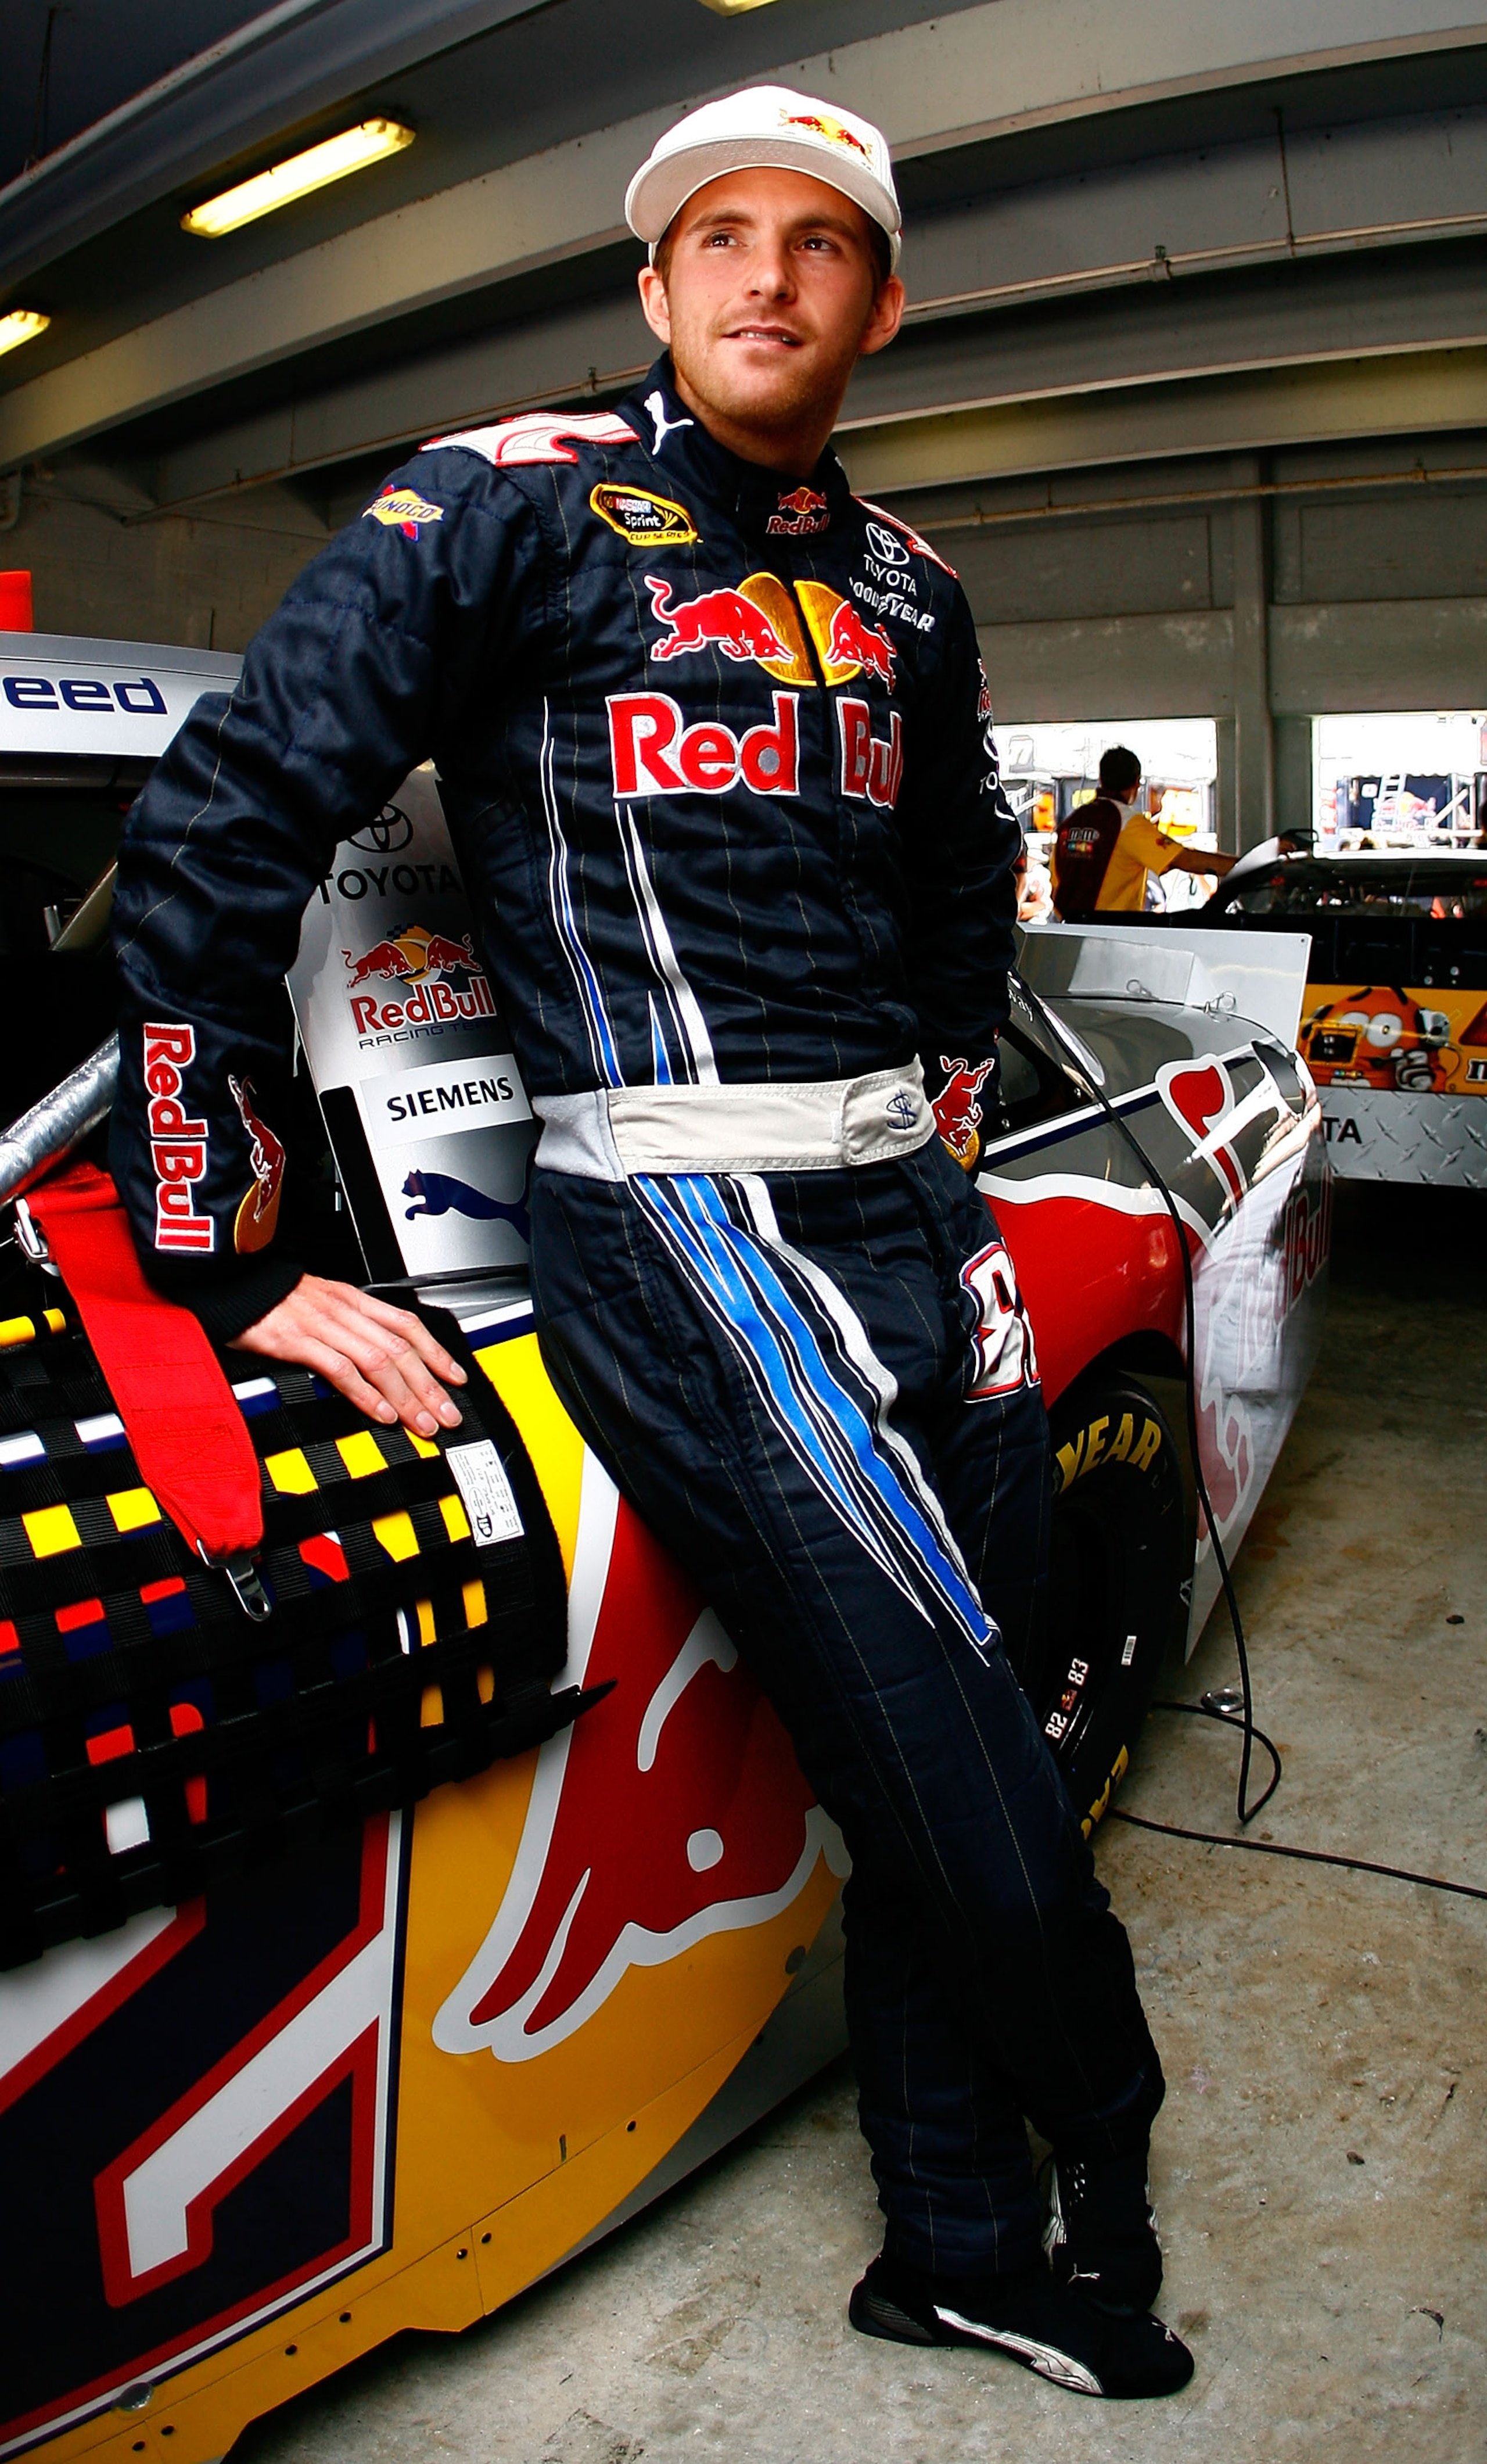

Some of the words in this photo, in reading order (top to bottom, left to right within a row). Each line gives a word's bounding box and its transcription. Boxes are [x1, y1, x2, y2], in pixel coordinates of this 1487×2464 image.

[624, 513, 662, 529] Sprint
[766, 515, 803, 535] Red
[863, 554, 918, 597] TOYOTA
[849, 576, 936, 633] OODYEAR
[605, 691, 800, 798] Red
[835, 695, 903, 810] Bull
[318, 865, 463, 905] TOYOTA
[347, 983, 434, 1036] Red
[430, 975, 498, 1024] Bull
[359, 1023, 444, 1050] RACING
[143, 1022, 209, 1140] Red
[386, 1076, 514, 1122] SIEMENS
[150, 1140, 215, 1253] Bull
[1055, 1412, 1162, 1494] YEAR
[1068, 1657, 1089, 1687] 83
[1044, 1711, 1068, 1739] 82
